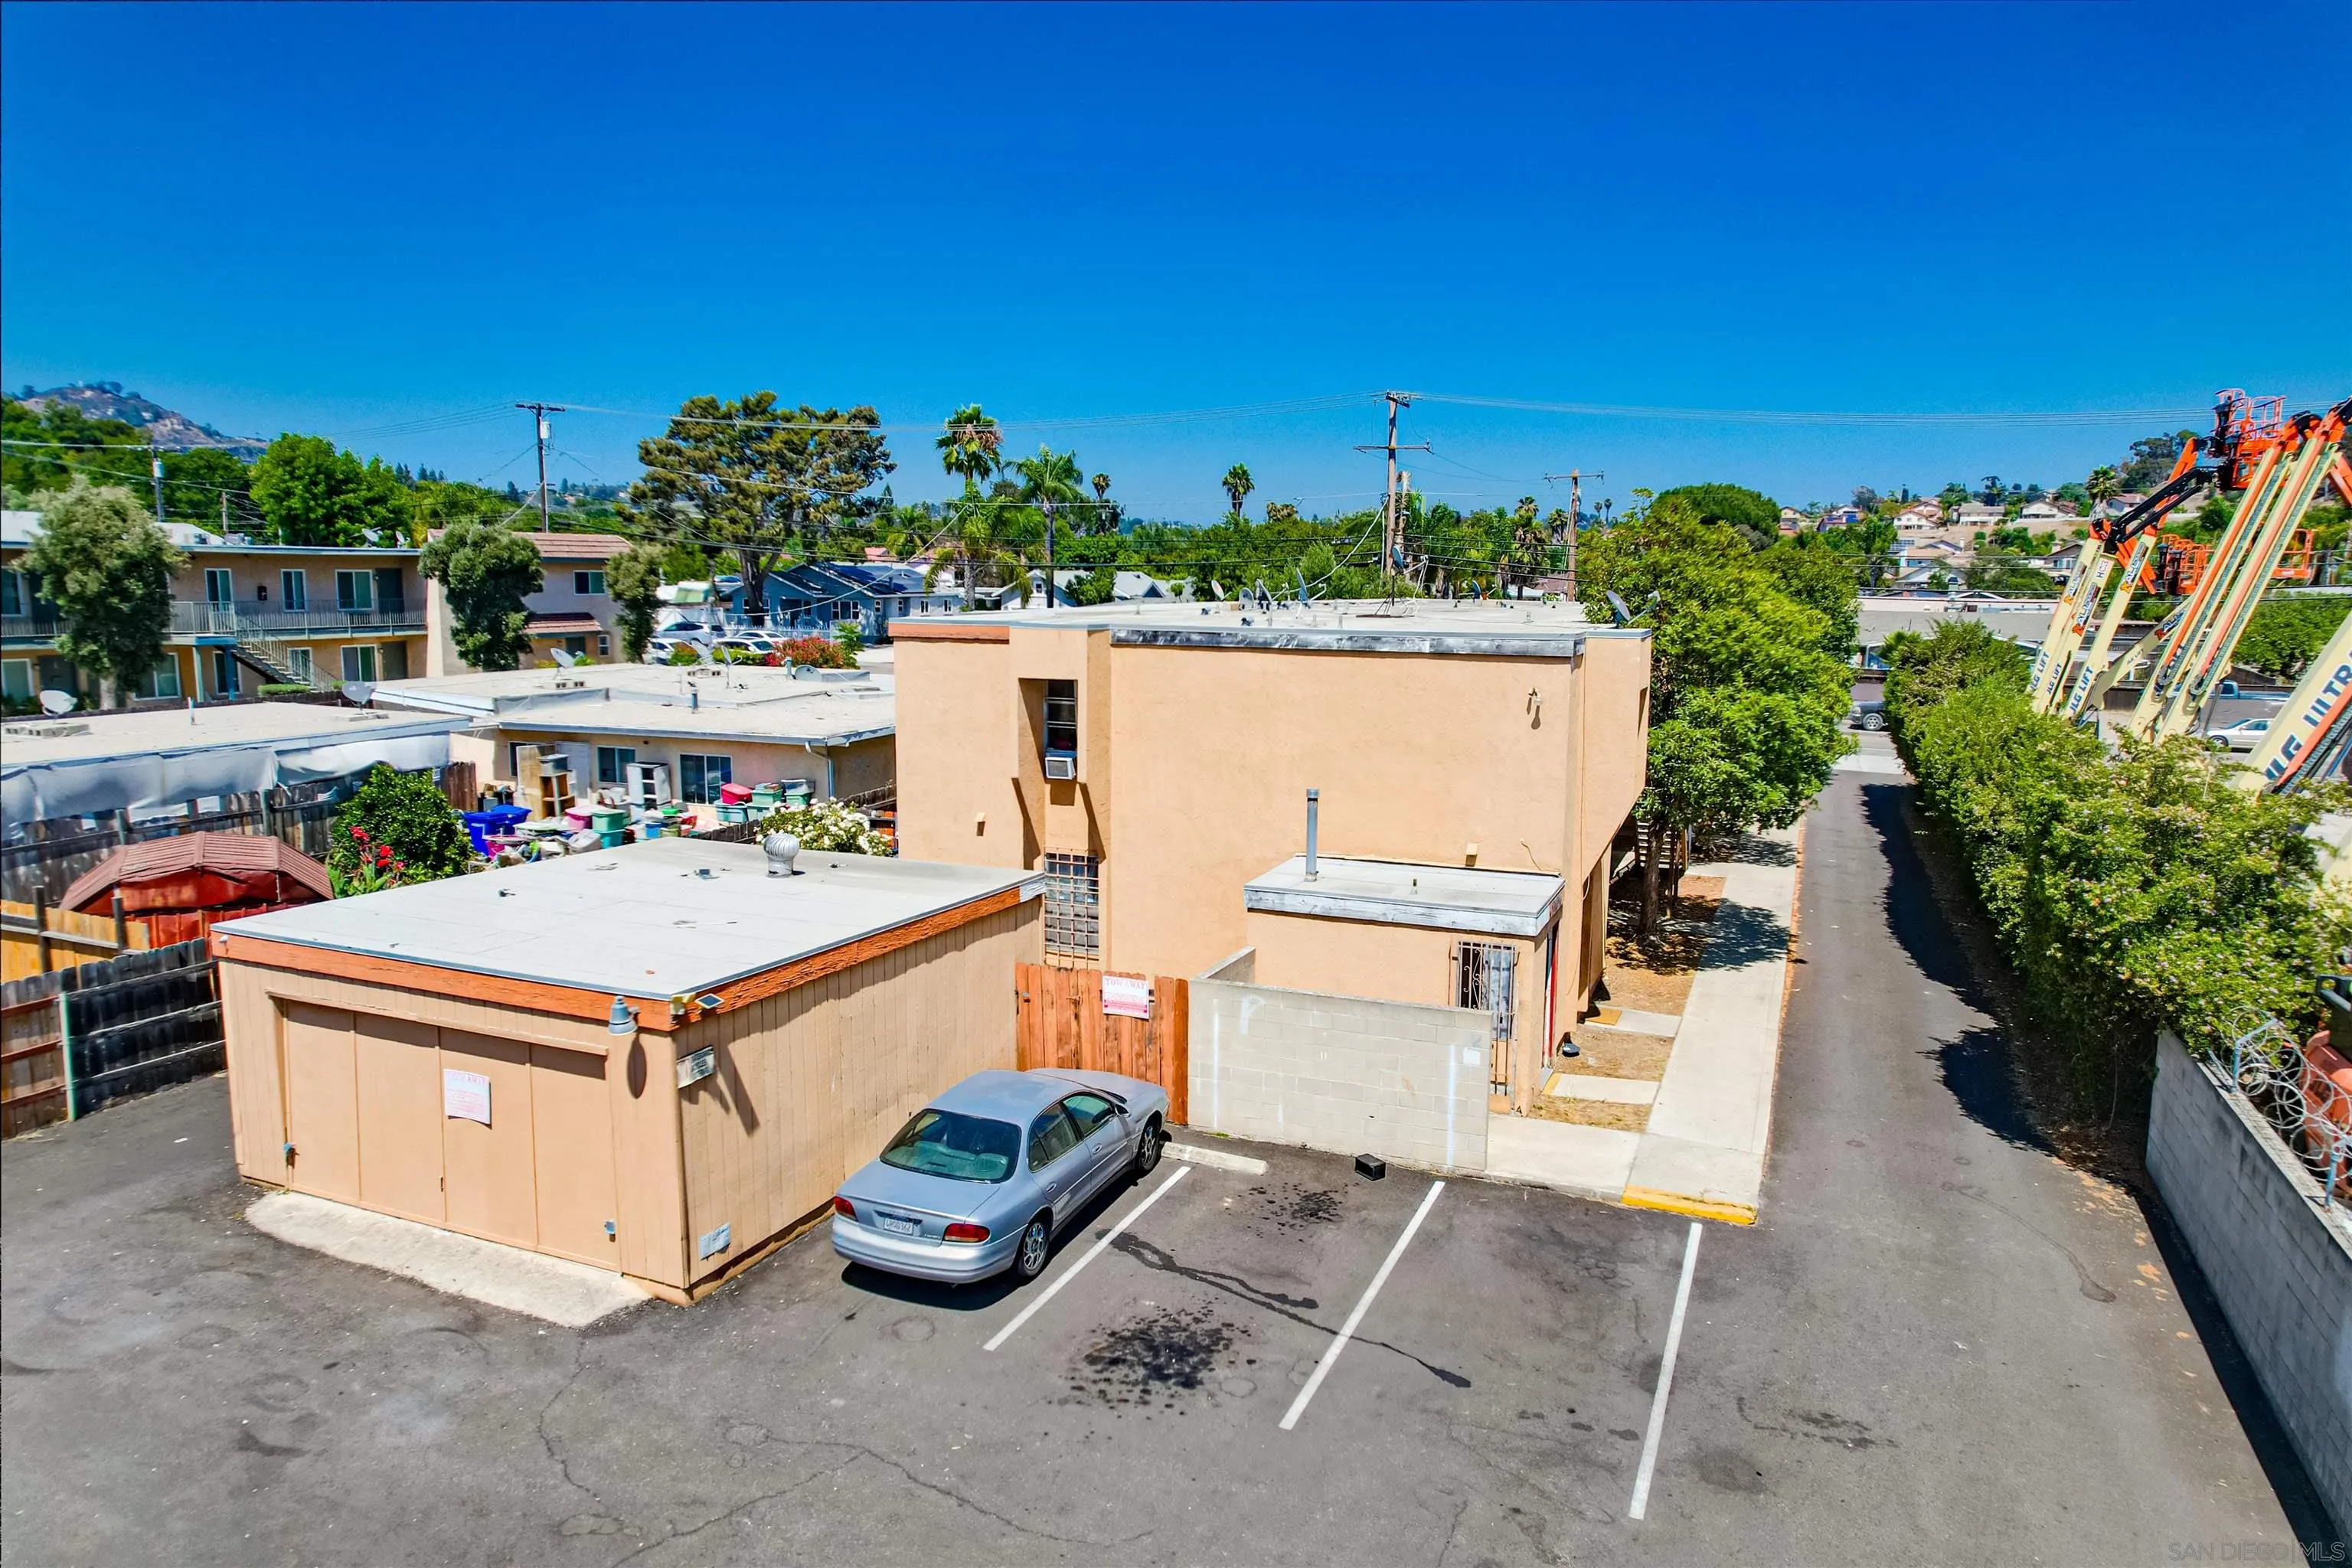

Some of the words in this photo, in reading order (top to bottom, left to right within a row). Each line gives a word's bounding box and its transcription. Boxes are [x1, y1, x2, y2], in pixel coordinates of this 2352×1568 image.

[2037, 651, 2050, 673] LIFT
[2046, 681, 2055, 694] JLG
[2052, 662, 2062, 680] LIFT
[2069, 692, 2082, 714] JLG
[2079, 665, 2093, 692] LIFT
